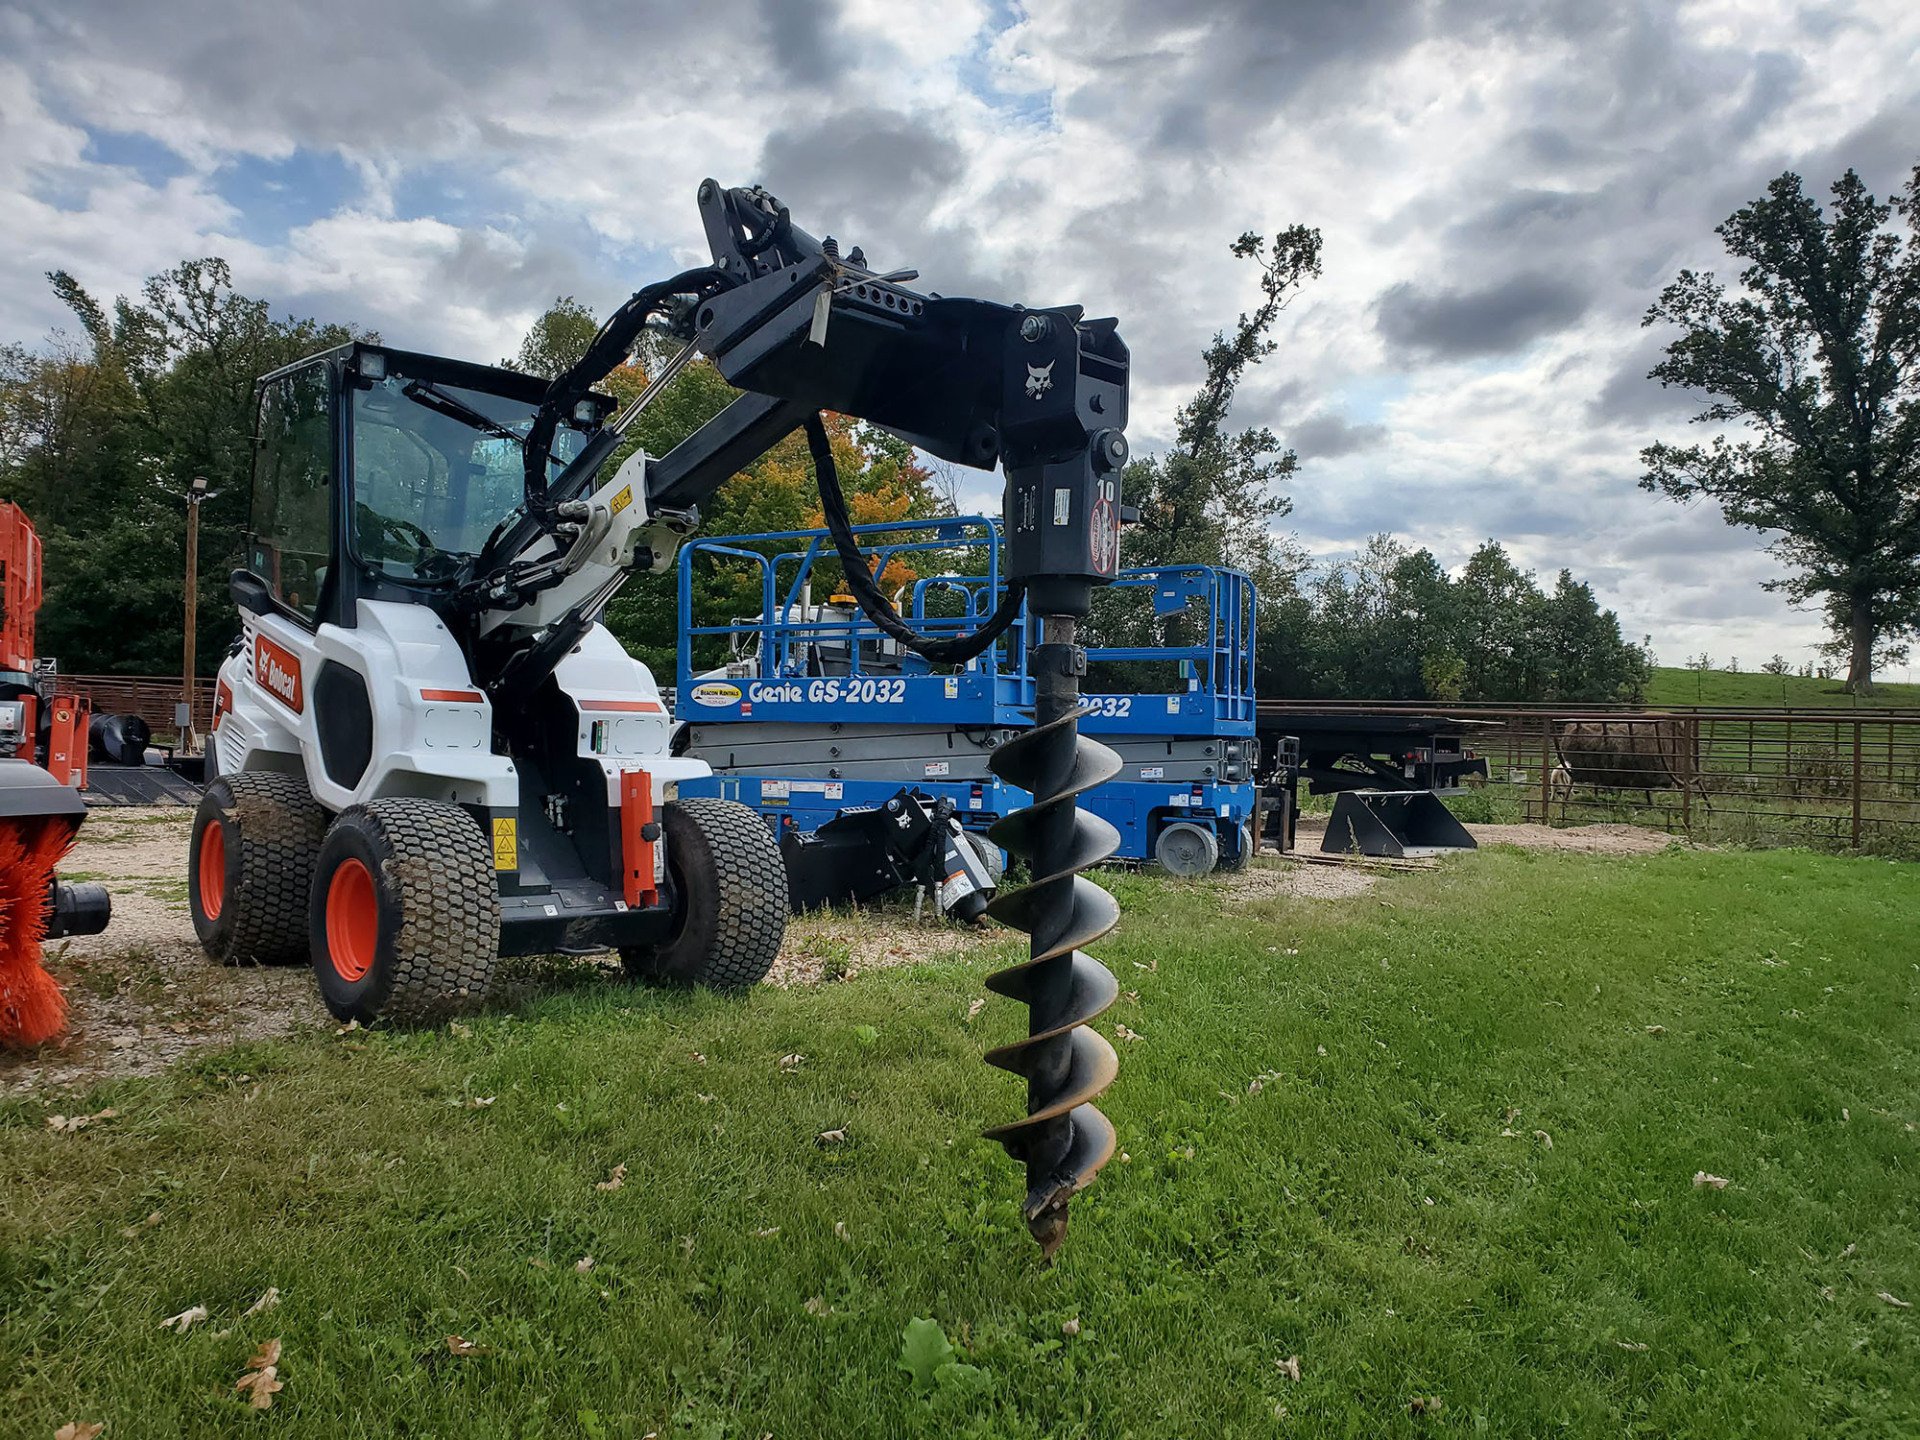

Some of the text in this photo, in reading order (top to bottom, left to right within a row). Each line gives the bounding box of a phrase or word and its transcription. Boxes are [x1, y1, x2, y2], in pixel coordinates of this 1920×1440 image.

[1097, 479, 1115, 502] 10
[268, 659, 295, 701] Bobcat
[748, 680, 906, 703] Genie GS-2032
